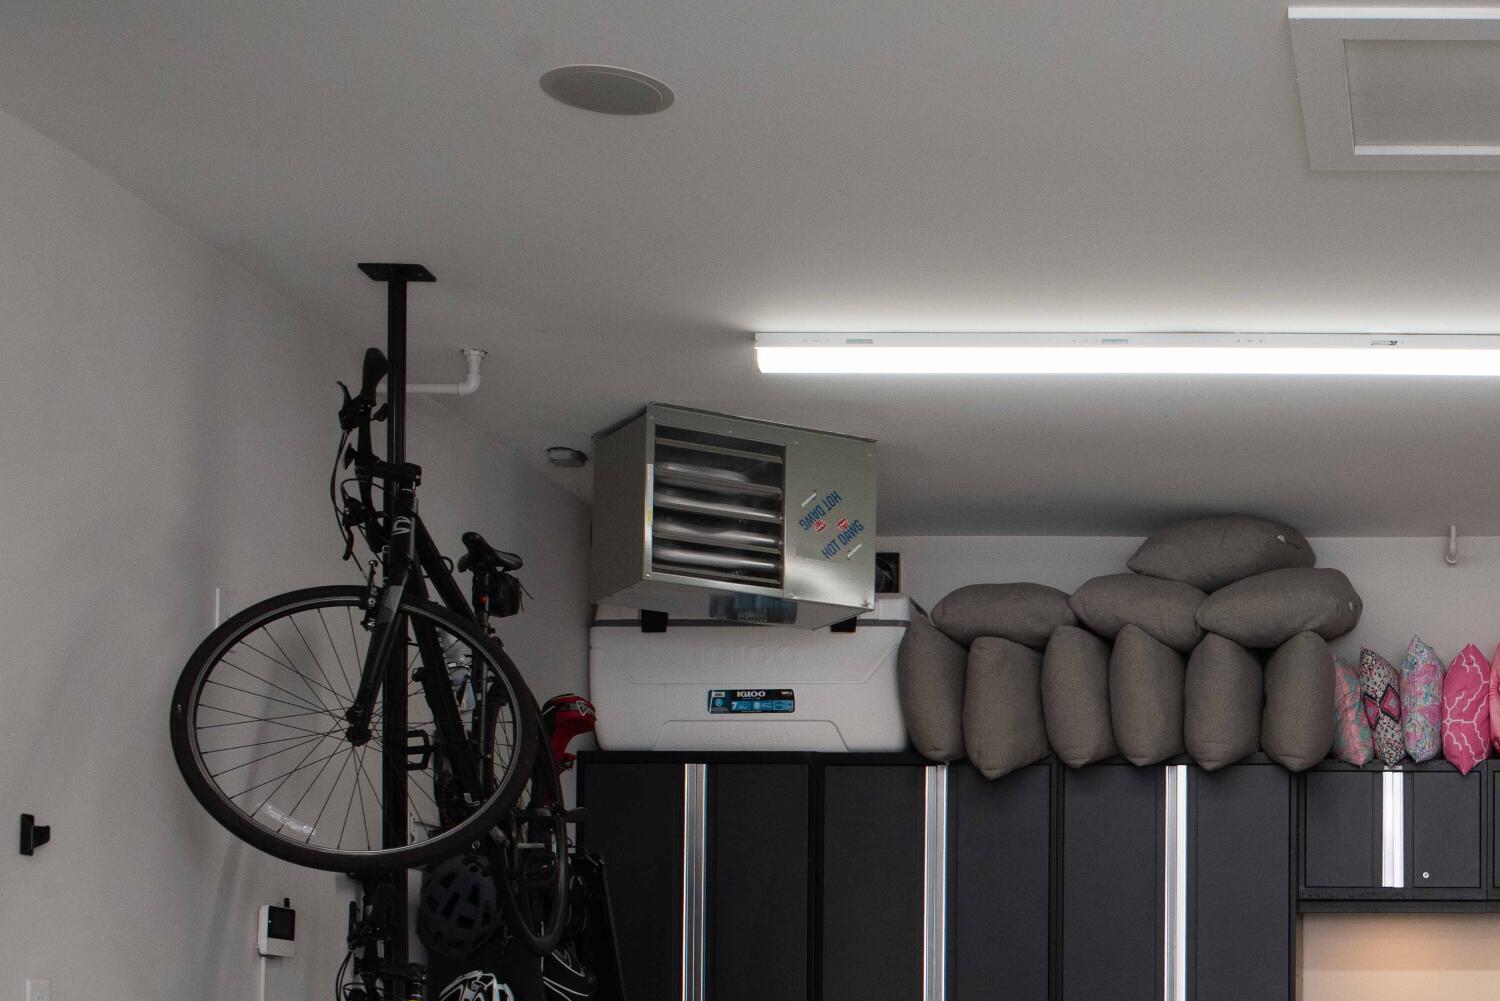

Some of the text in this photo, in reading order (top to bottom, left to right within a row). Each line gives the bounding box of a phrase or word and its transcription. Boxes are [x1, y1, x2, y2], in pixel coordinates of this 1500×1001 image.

[822, 490, 842, 512] HOT
[799, 504, 826, 531] DAWG
[821, 538, 841, 560] HOT
[837, 519, 864, 546] DAWG
